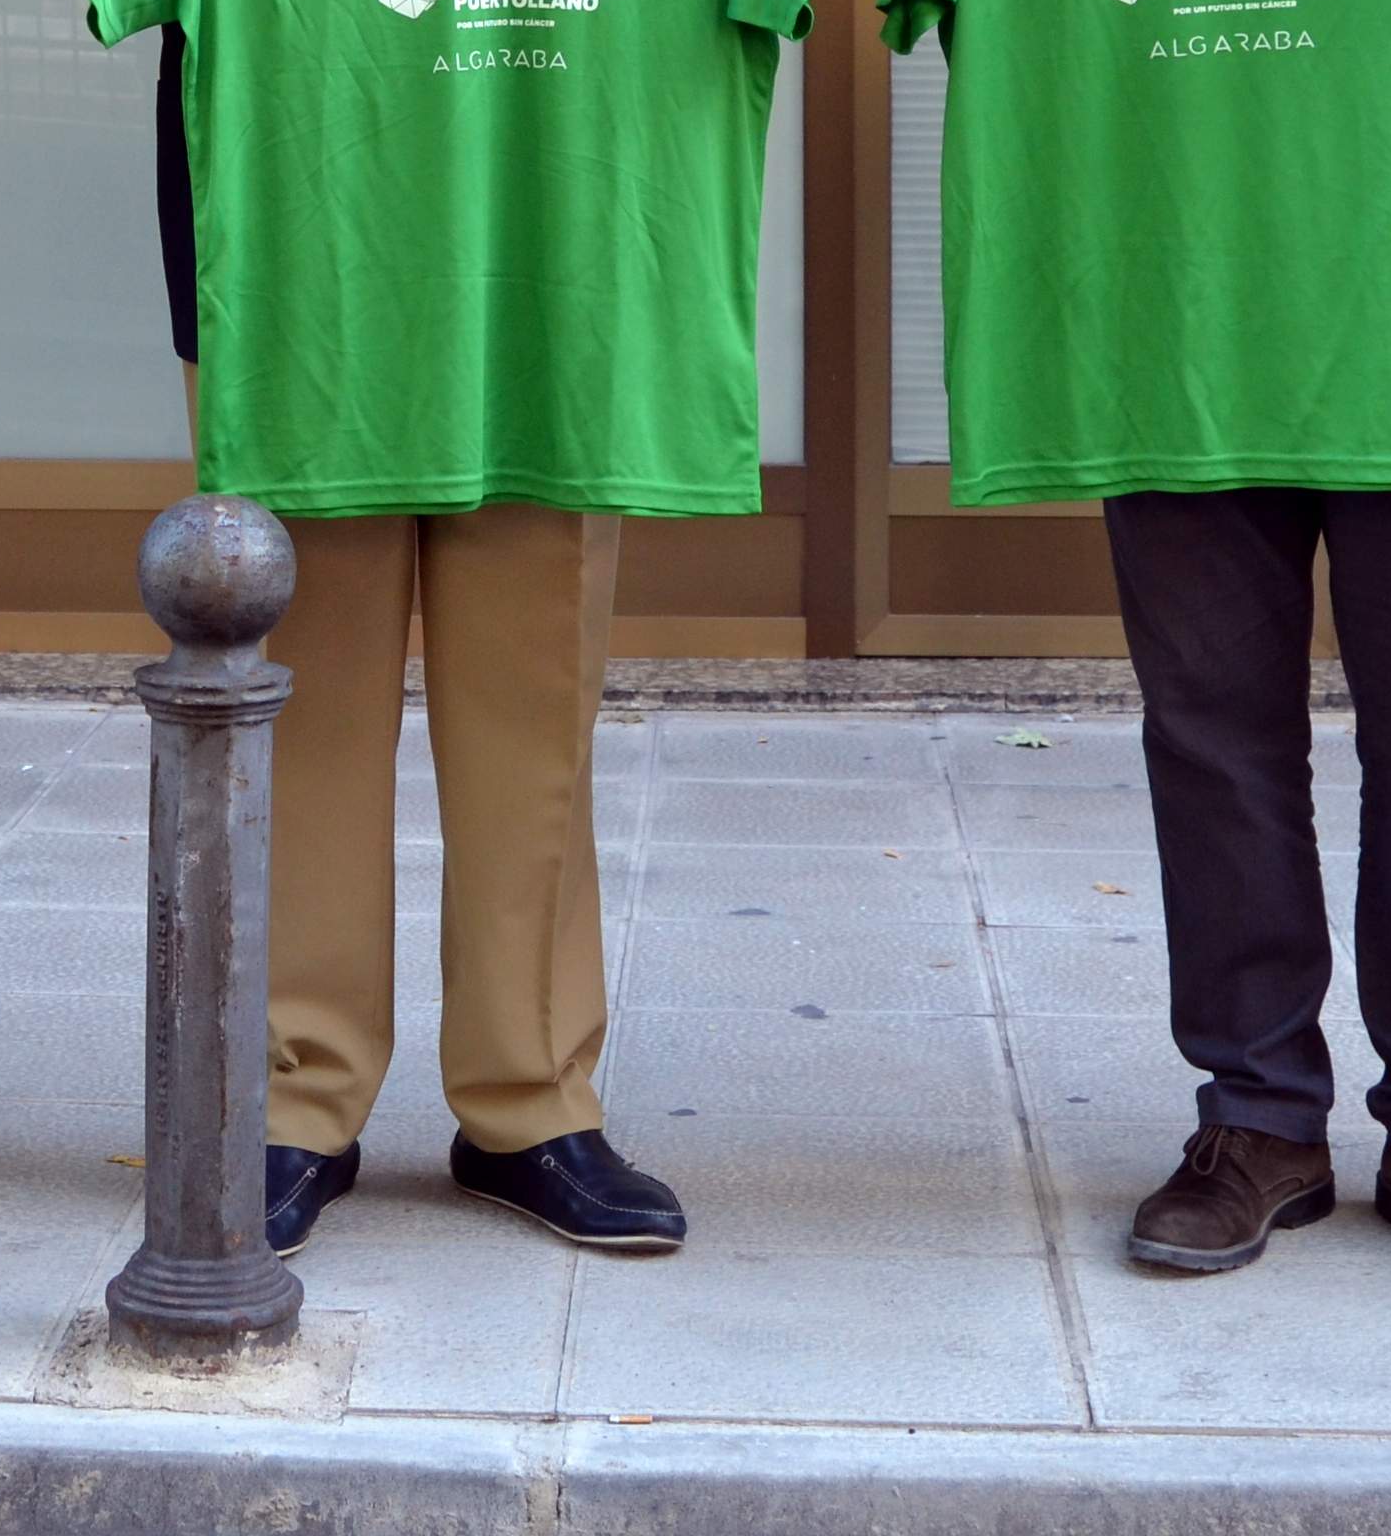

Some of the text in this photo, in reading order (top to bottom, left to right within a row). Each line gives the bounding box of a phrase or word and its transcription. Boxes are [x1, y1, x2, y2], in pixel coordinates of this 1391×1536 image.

[1173, 6, 1192, 16] POR
[457, 21, 472, 30] POR
[524, 17, 555, 27] CÁNCER
[1149, 29, 1316, 60] ALGARABA
[432, 48, 568, 74] ALGARABA
